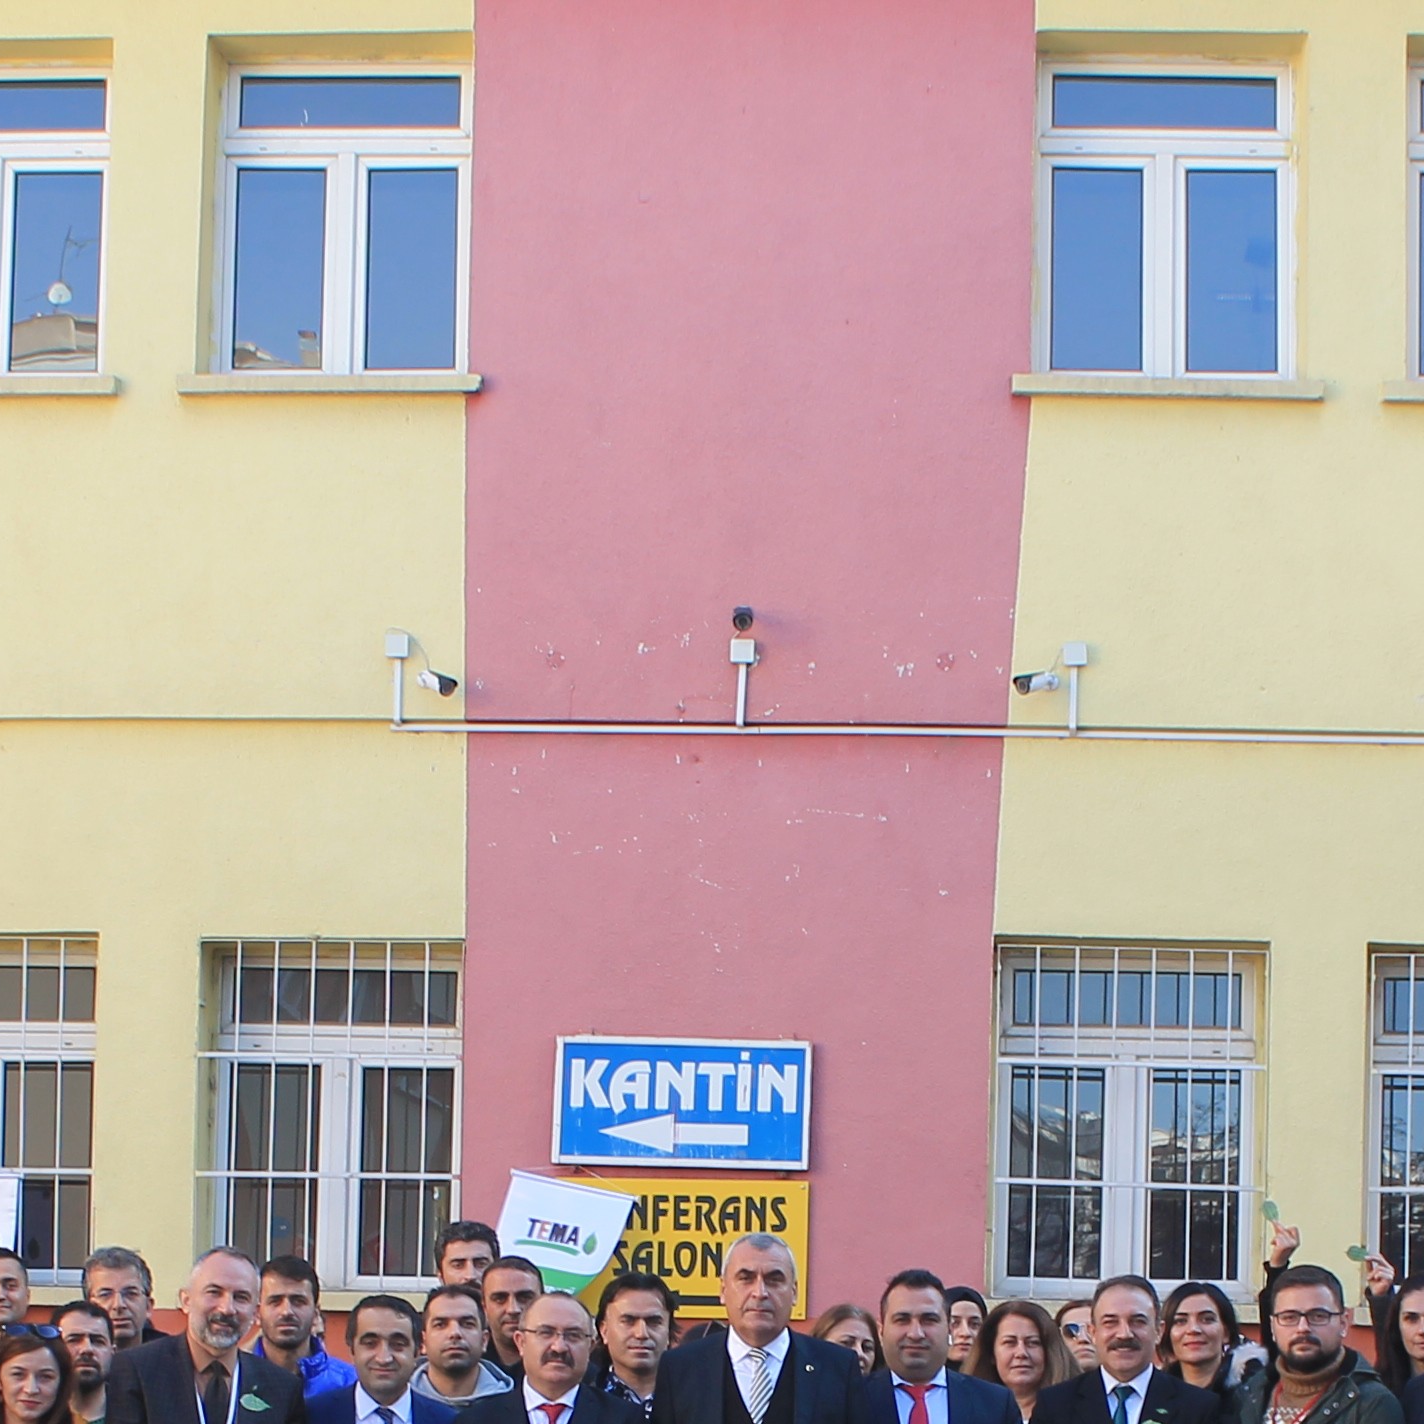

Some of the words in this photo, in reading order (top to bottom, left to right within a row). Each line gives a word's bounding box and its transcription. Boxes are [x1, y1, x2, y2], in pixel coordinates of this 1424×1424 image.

[569, 1051, 798, 1115] KANTİN
[527, 1217, 580, 1247] TEMA
[626, 1194, 788, 1235] NFERANS
[612, 1240, 723, 1278] SALON
